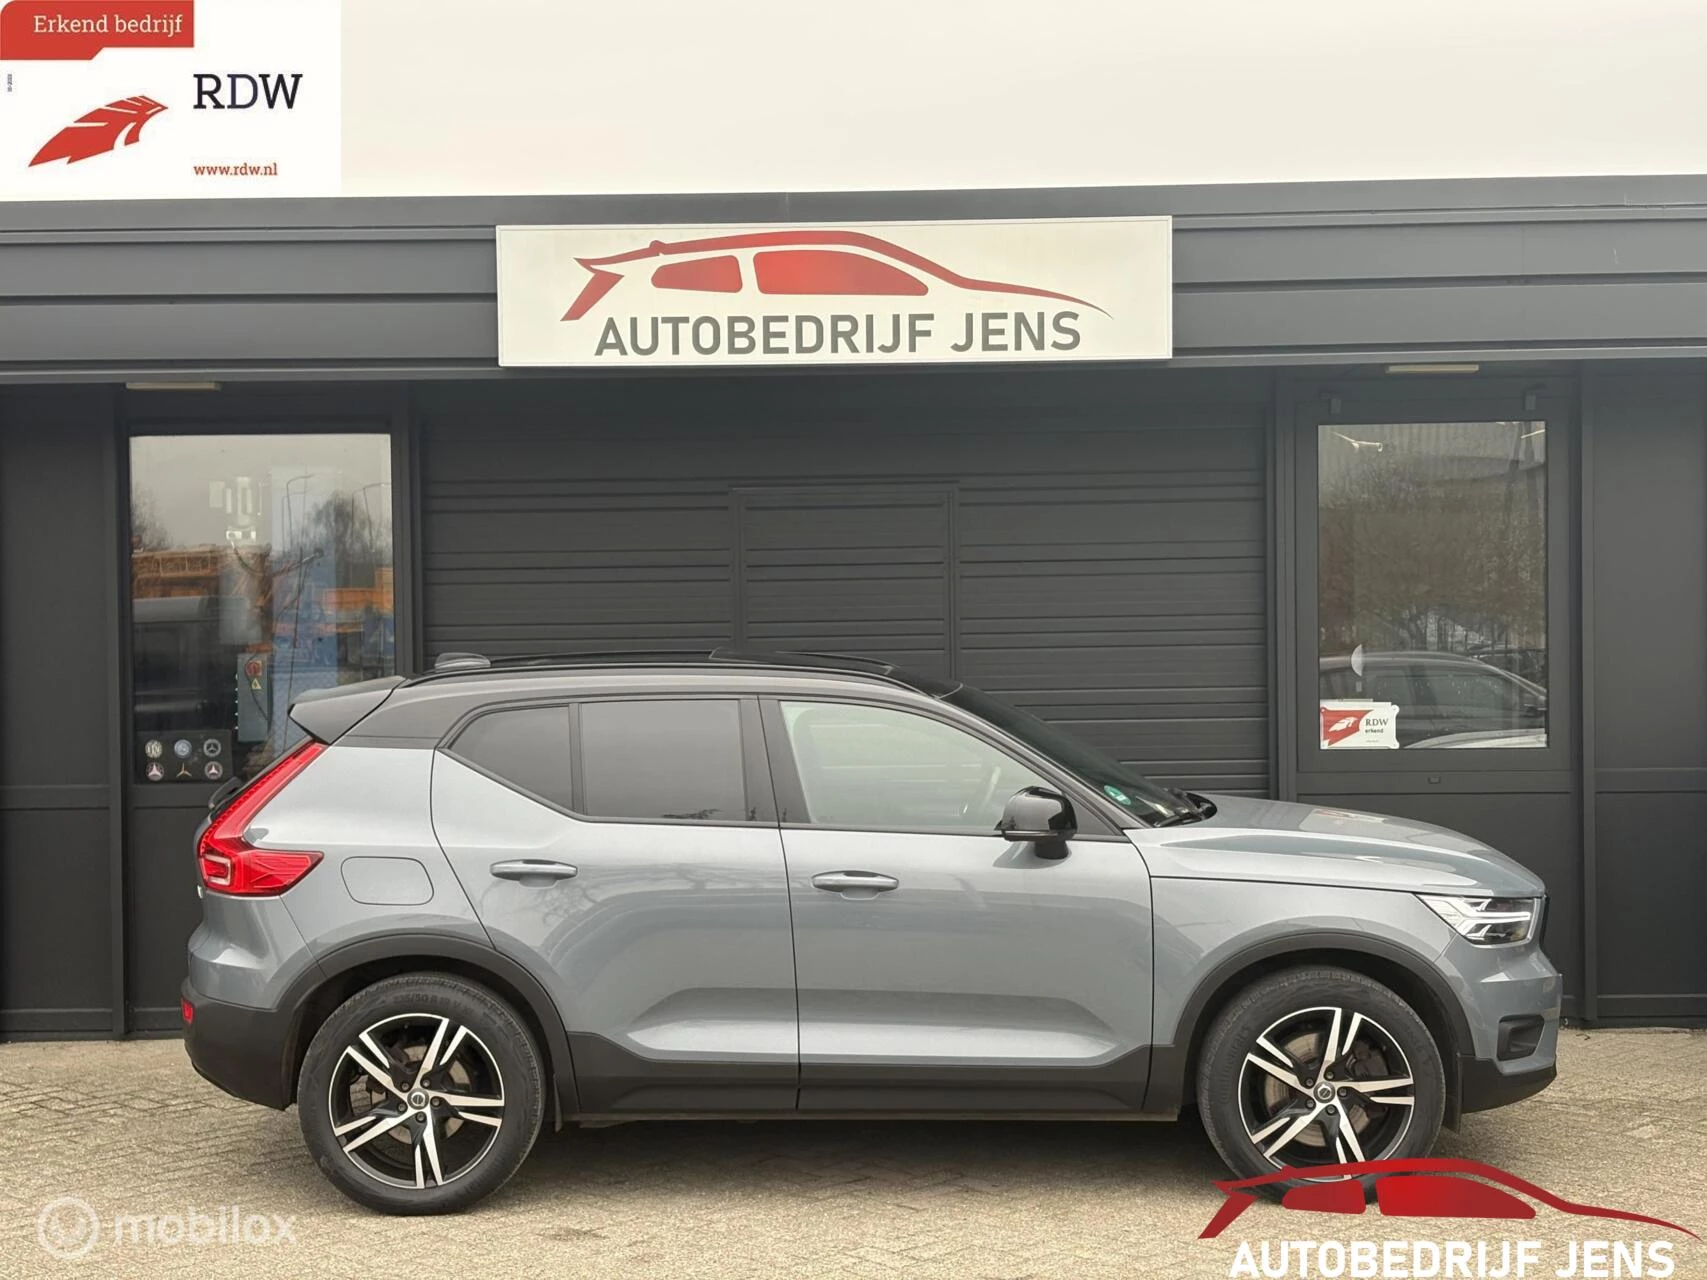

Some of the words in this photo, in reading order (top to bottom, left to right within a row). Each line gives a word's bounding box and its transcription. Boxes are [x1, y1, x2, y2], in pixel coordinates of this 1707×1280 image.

[594, 314, 935, 356] AUTOBEDRIJF
[951, 311, 1081, 352] JENS
[1365, 718, 1388, 726] RDW
